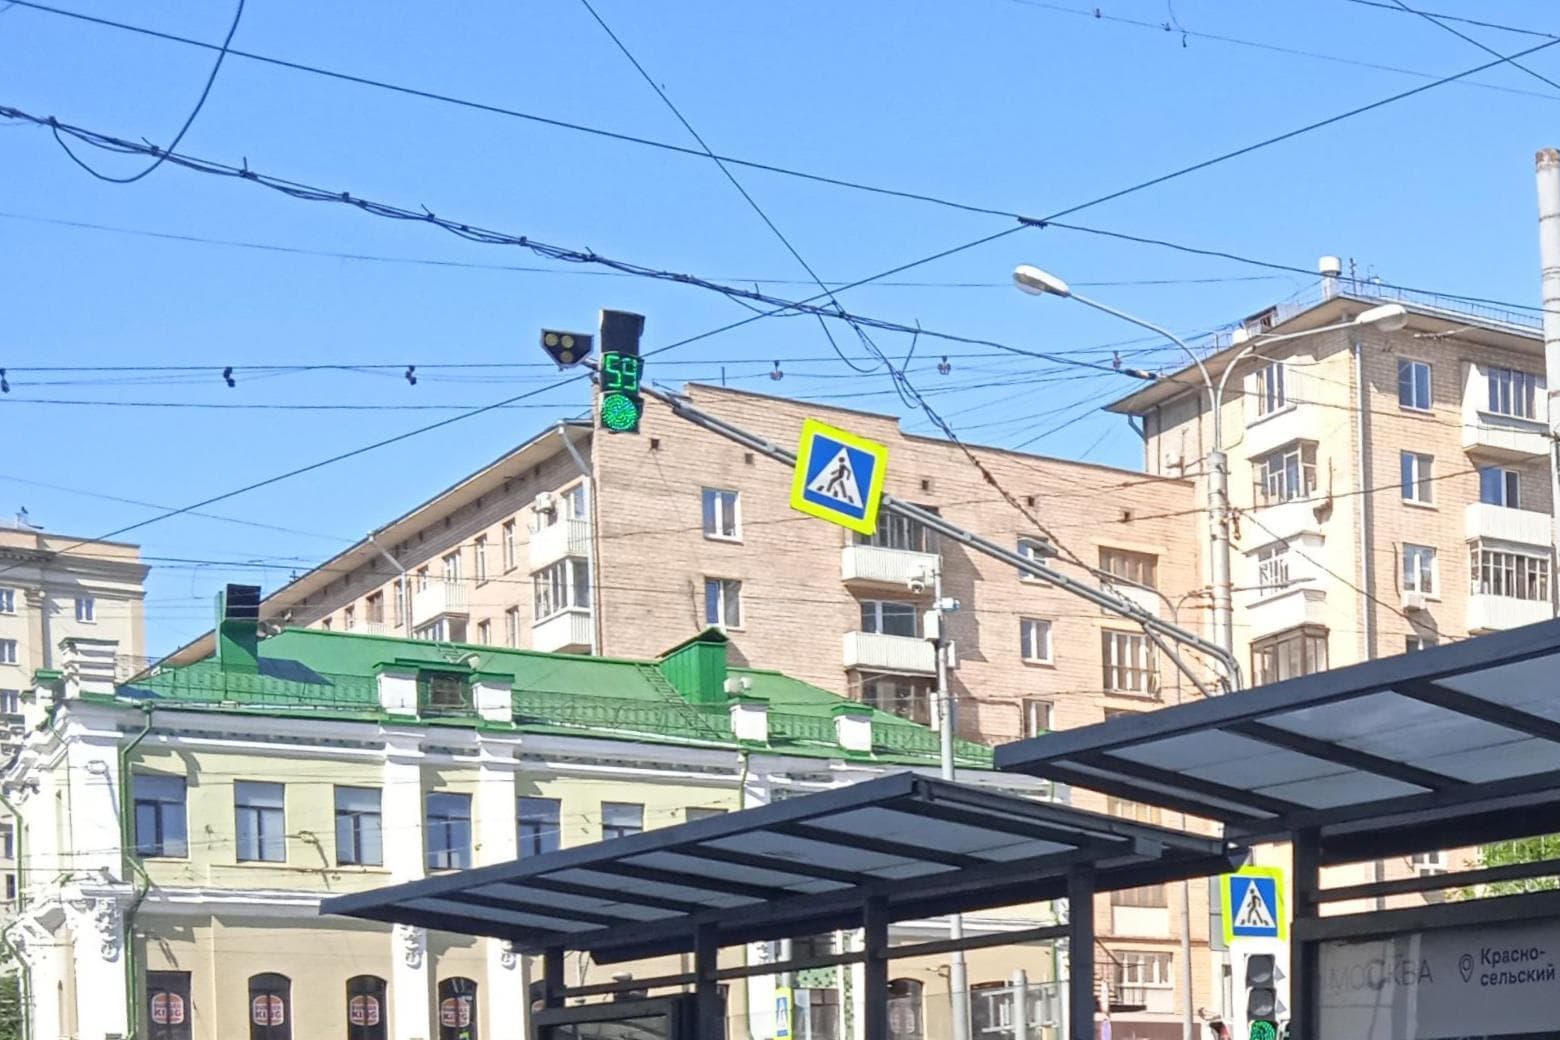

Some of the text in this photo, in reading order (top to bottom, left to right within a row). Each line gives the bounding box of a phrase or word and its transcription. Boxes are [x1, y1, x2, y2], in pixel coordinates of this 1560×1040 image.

[606, 355, 637, 390] 59
[1480, 947, 1547, 968] Красно-
[1480, 963, 1555, 986] сельский
